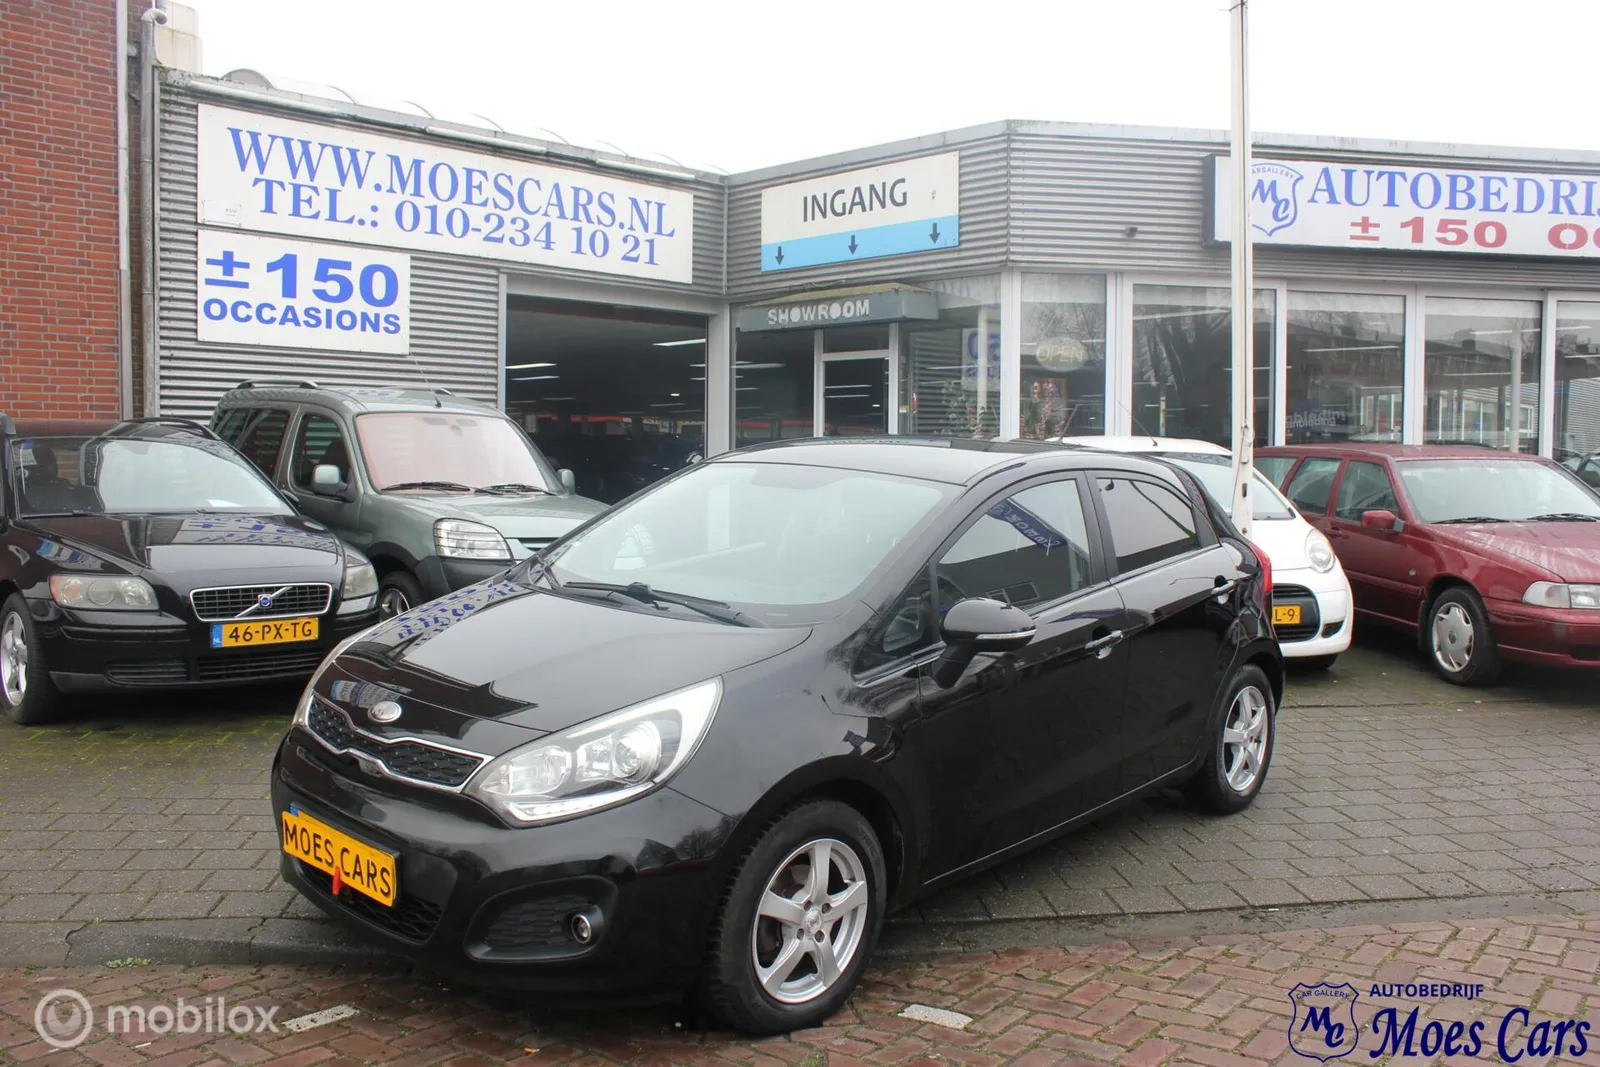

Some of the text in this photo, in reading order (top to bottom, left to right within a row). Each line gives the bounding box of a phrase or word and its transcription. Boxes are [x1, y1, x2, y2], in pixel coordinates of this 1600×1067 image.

[226, 127, 675, 238] WWW.MOESCARS.NL
[1252, 167, 1294, 179] ARGALLERY
[803, 178, 908, 222] INGANG
[252, 177, 659, 266] TEL.: 010-234 10 21
[1400, 216, 1507, 248] 150
[1548, 223, 1600, 250] O
[266, 253, 399, 308] 150
[203, 298, 401, 335] OCCASIONS
[767, 299, 870, 325] SHOWROOM
[1036, 344, 1083, 363] OPEN
[228, 621, 312, 642] 46-PX-TG
[1275, 608, 1296, 622] L-9
[284, 819, 391, 898] MOES CARS
